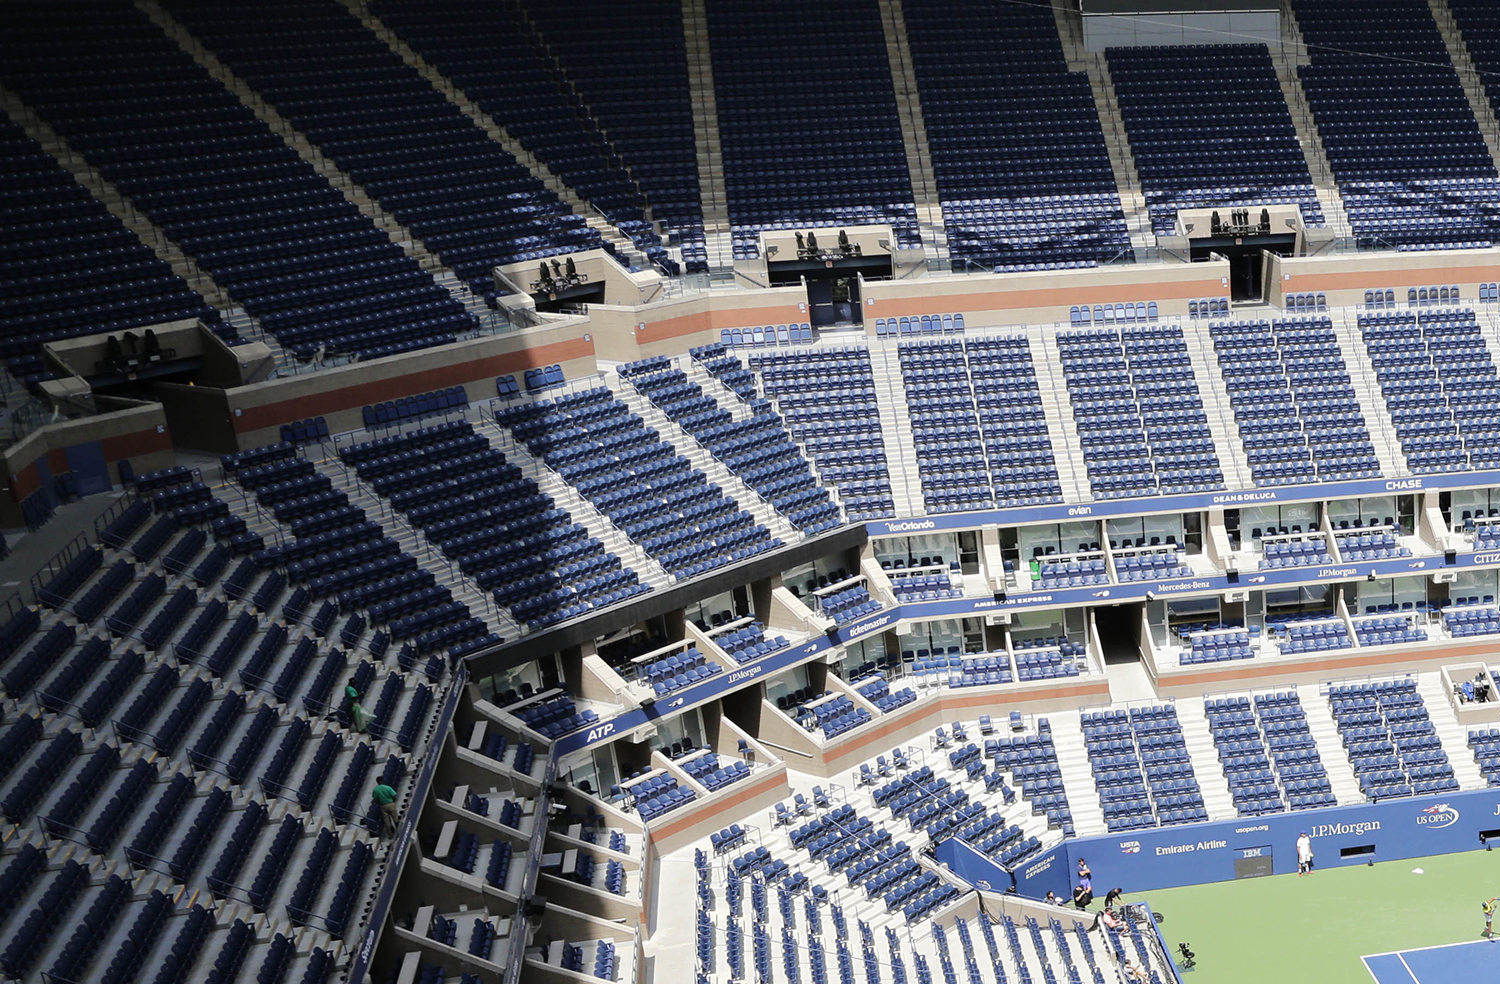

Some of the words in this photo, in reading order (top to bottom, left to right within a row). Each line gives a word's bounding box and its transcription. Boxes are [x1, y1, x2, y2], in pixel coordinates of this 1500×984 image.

[1386, 479, 1422, 490] CHASE
[1068, 506, 1092, 516] evian
[1158, 580, 1210, 592] Mercedes-Benz
[974, 598, 1016, 608] AMERICAN
[1017, 595, 1052, 604] EXPRESS
[850, 615, 891, 637] ticketmaster
[1416, 816, 1427, 825] US
[1428, 813, 1454, 824] OPEN
[1235, 824, 1269, 834] usopen.org
[1156, 844, 1195, 856] Emirates
[1196, 839, 1227, 851] Airline
[1243, 848, 1262, 858] IBM
[1025, 855, 1055, 874] AMERICAN
[1026, 864, 1051, 880] EXPRESS
